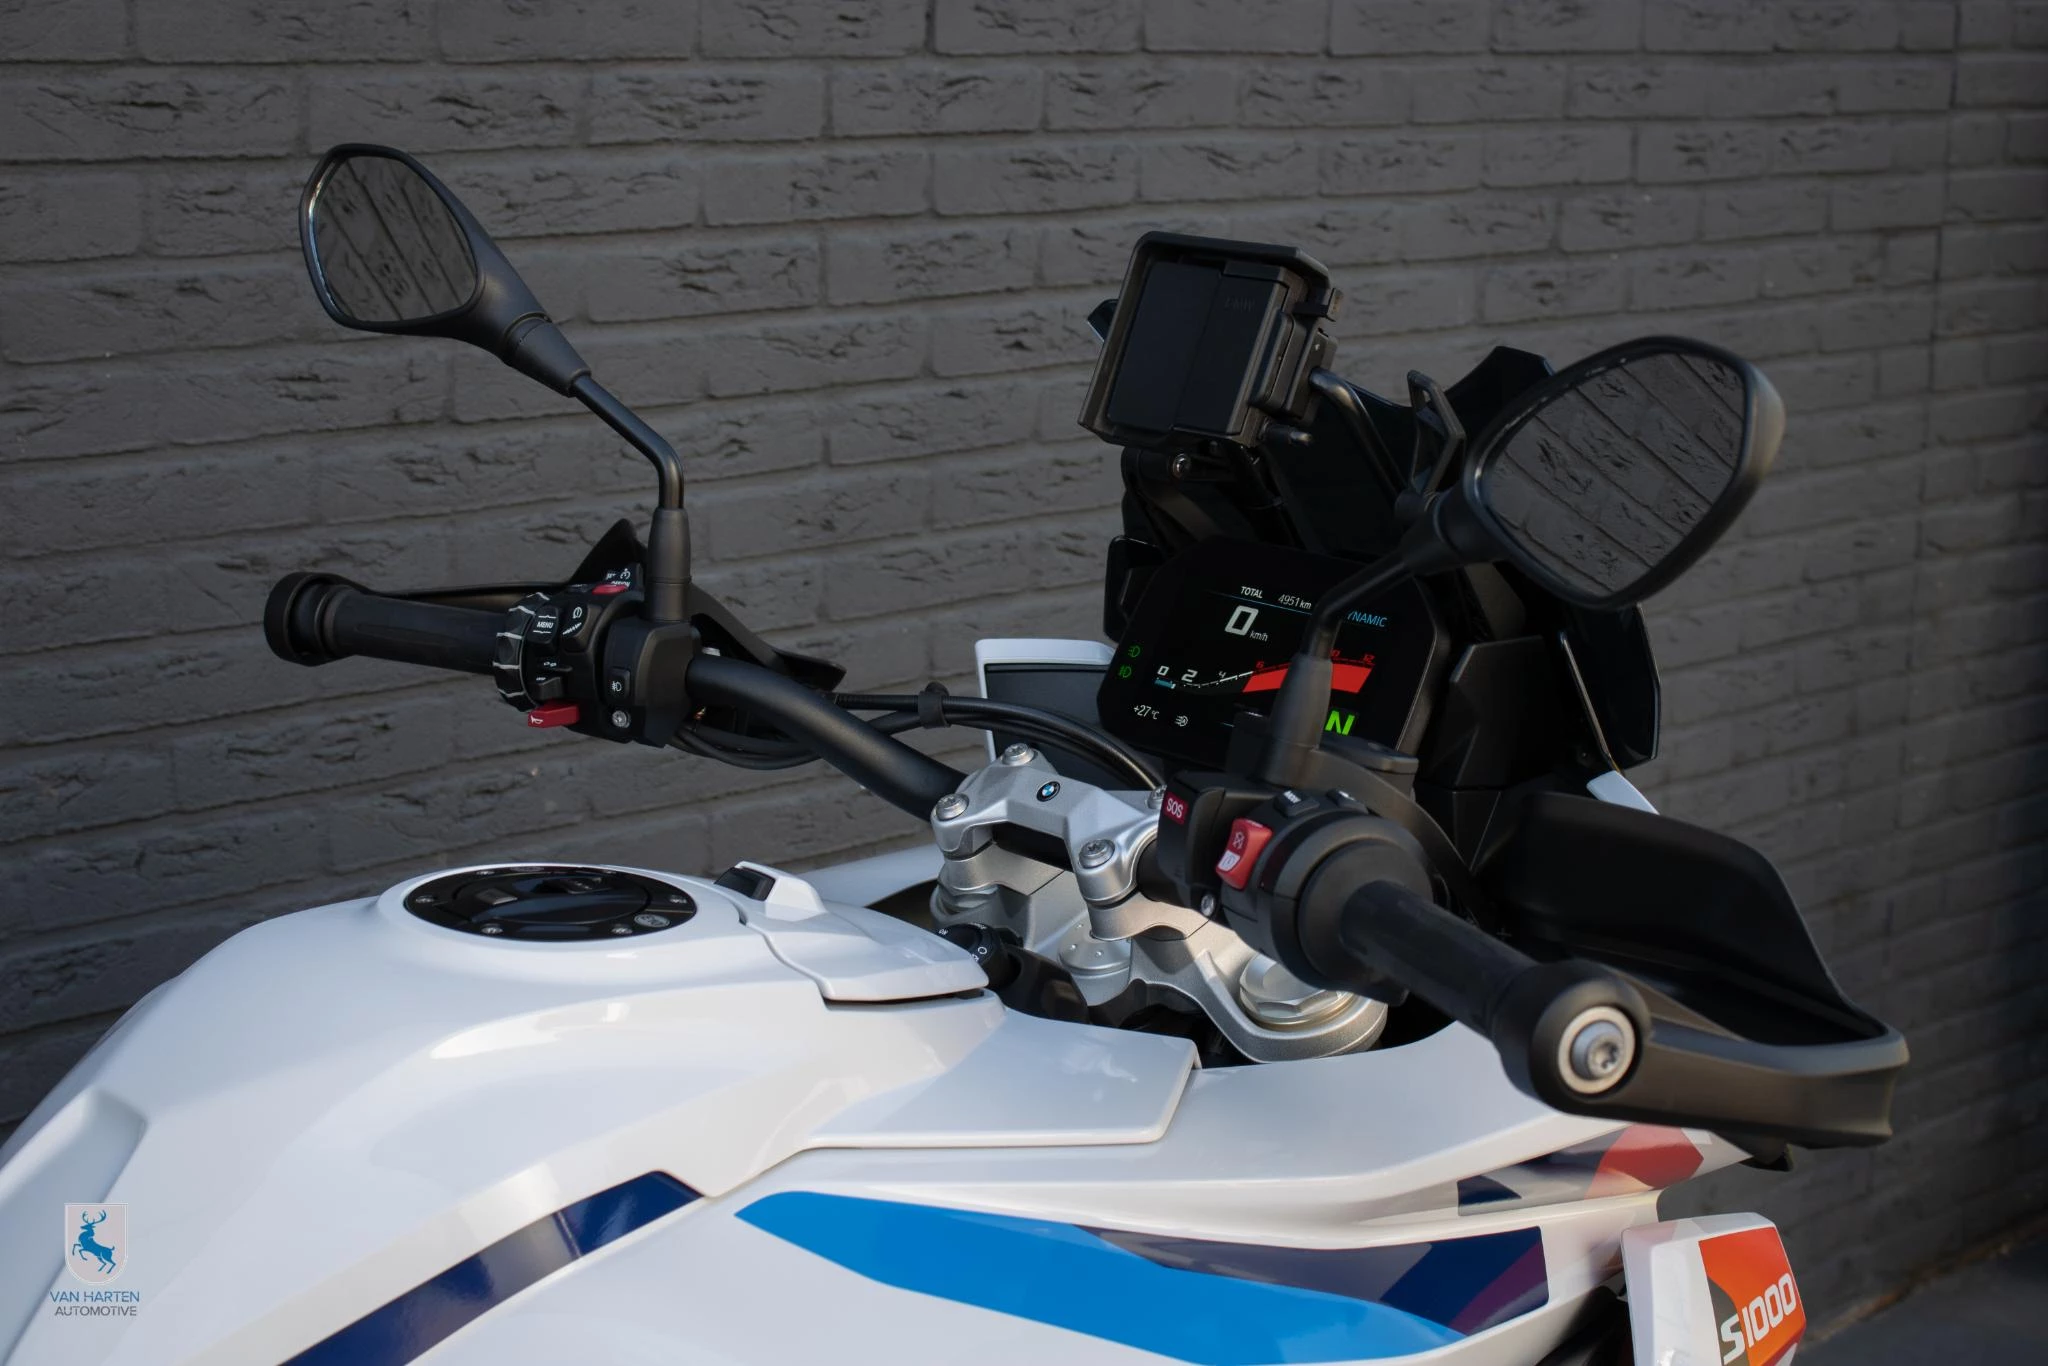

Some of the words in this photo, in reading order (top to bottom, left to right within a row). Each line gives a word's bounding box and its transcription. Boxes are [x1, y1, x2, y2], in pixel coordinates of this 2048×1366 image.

[1241, 586, 1263, 599] TOTAL
[1278, 594, 1300, 606] 4951
[1300, 600, 1312, 609] km
[537, 621, 554, 629] MENU
[1225, 605, 1259, 636] 0
[1250, 631, 1268, 642] km/h
[1157, 665, 1170, 676] 0
[1181, 669, 1198, 682] 2
[1218, 671, 1227, 679] 4
[1324, 710, 1355, 736] N
[1167, 798, 1184, 818] SOS
[1720, 1273, 1796, 1365] S1000
